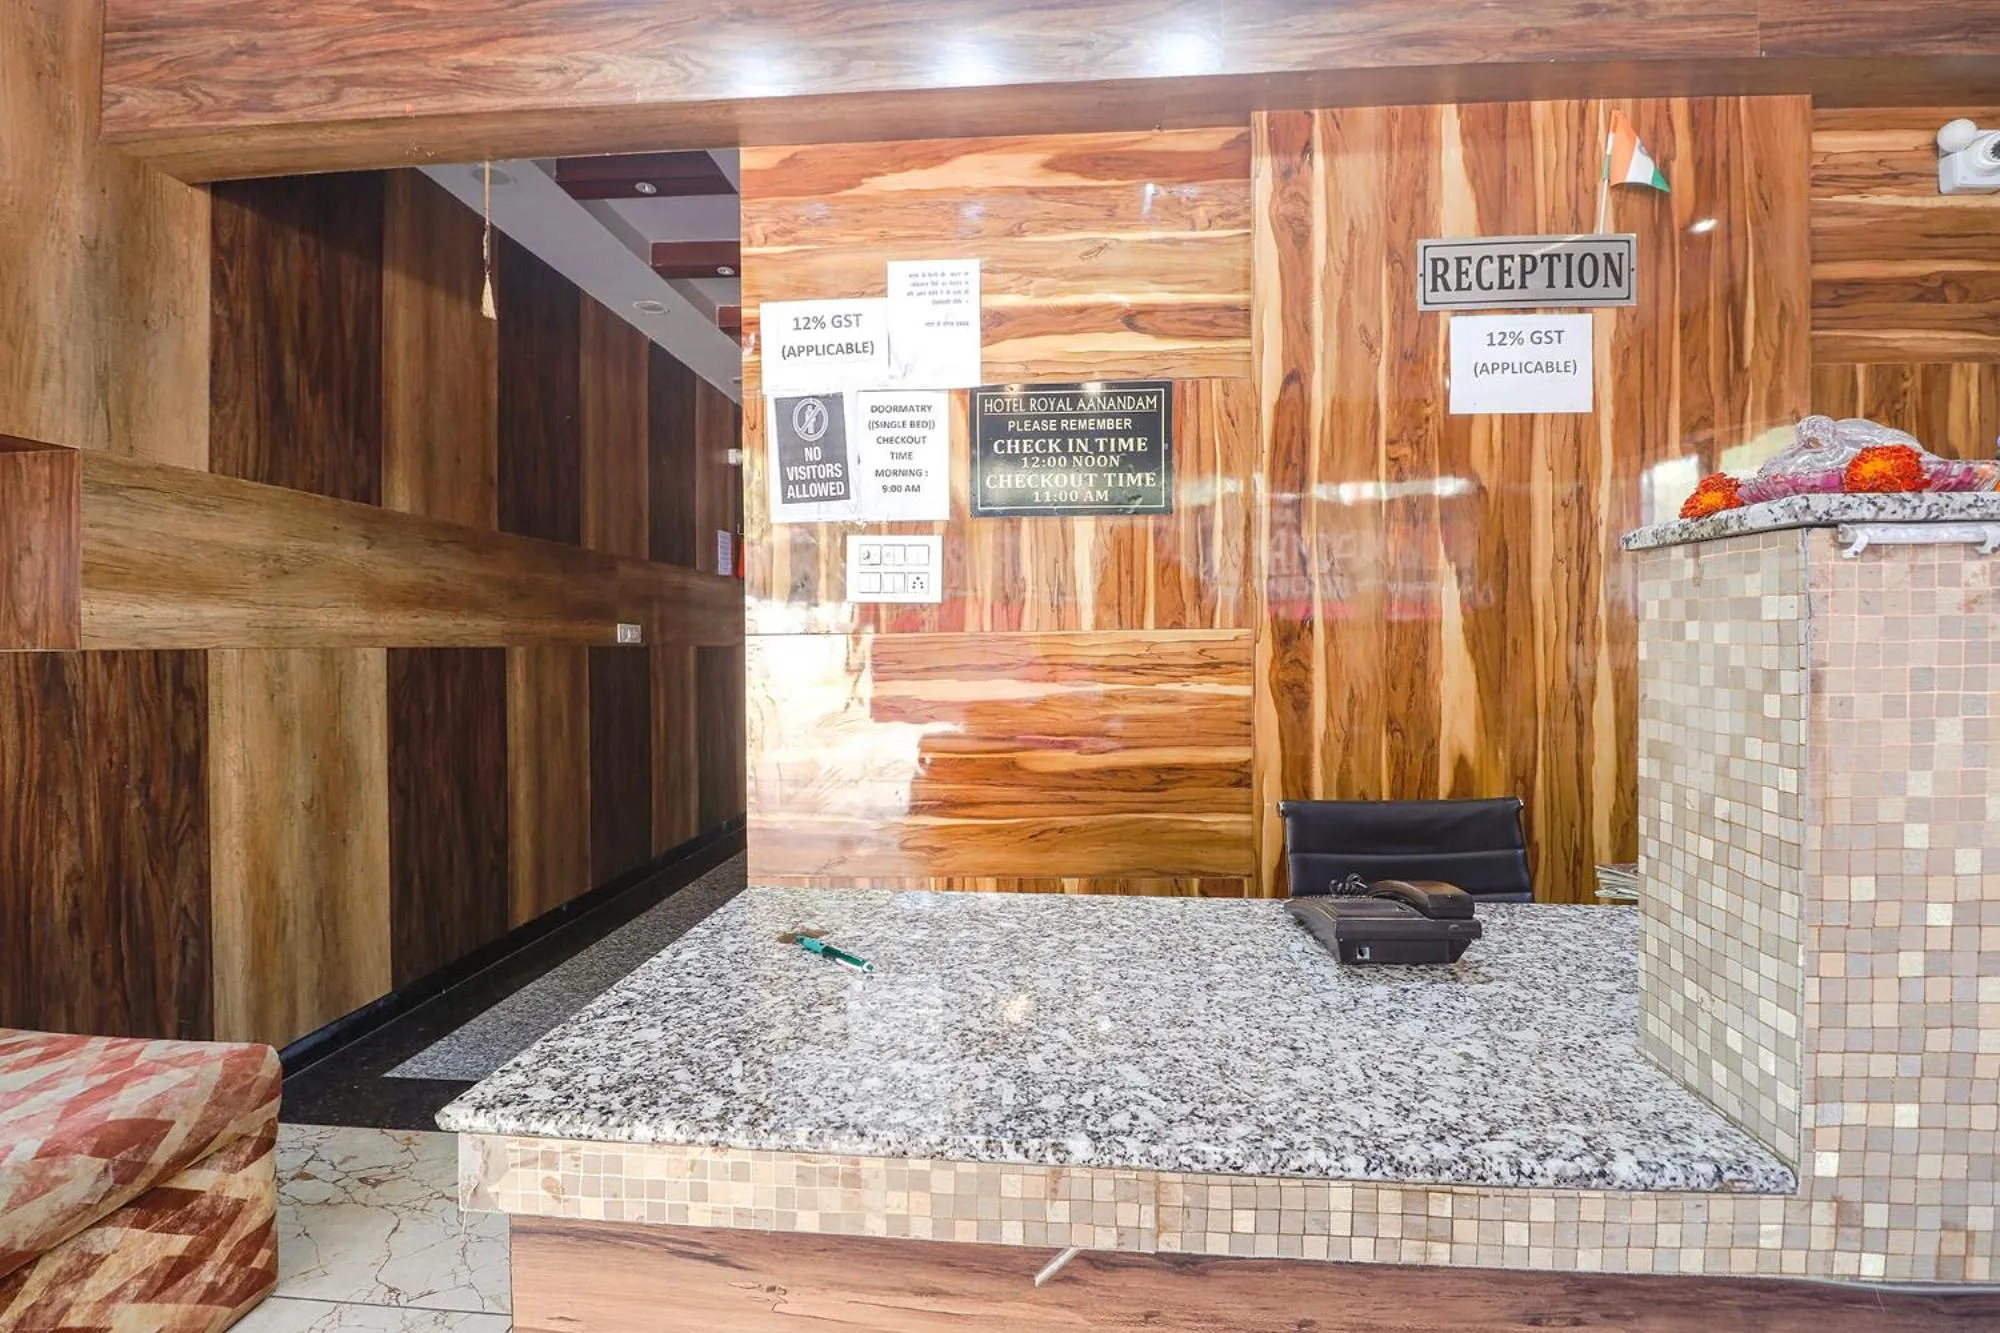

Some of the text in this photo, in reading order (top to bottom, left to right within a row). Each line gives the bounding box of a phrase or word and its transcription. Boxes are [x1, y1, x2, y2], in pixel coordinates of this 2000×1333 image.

[1430, 252, 1624, 292] RECEPTION
[792, 312, 863, 331] 12% GST
[1486, 329, 1565, 347] 12% GST
[781, 340, 874, 360] (APPLICABLE)
[1473, 359, 1578, 378] (APPLICABLE)
[870, 404, 933, 414] DOORMATRY
[984, 394, 1157, 413] HOTEL ROYAL AANANDAM
[1008, 418, 1133, 432] PLEASE REMEMBER
[876, 435, 927, 445] CHECKOUT
[993, 437, 1148, 454] CHECK IN TIME
[803, 447, 822, 462] NO
[890, 451, 913, 460] TIME
[1021, 455, 1121, 469] 12:00 NOON
[786, 463, 843, 481] VISITORS
[875, 468, 923, 478] MORNING
[985, 471, 1157, 489] CHECKOUT TIME
[786, 481, 845, 500] ALLOWED
[882, 484, 921, 494] 9:00 AM
[1033, 489, 1109, 503] 11:00 AM
